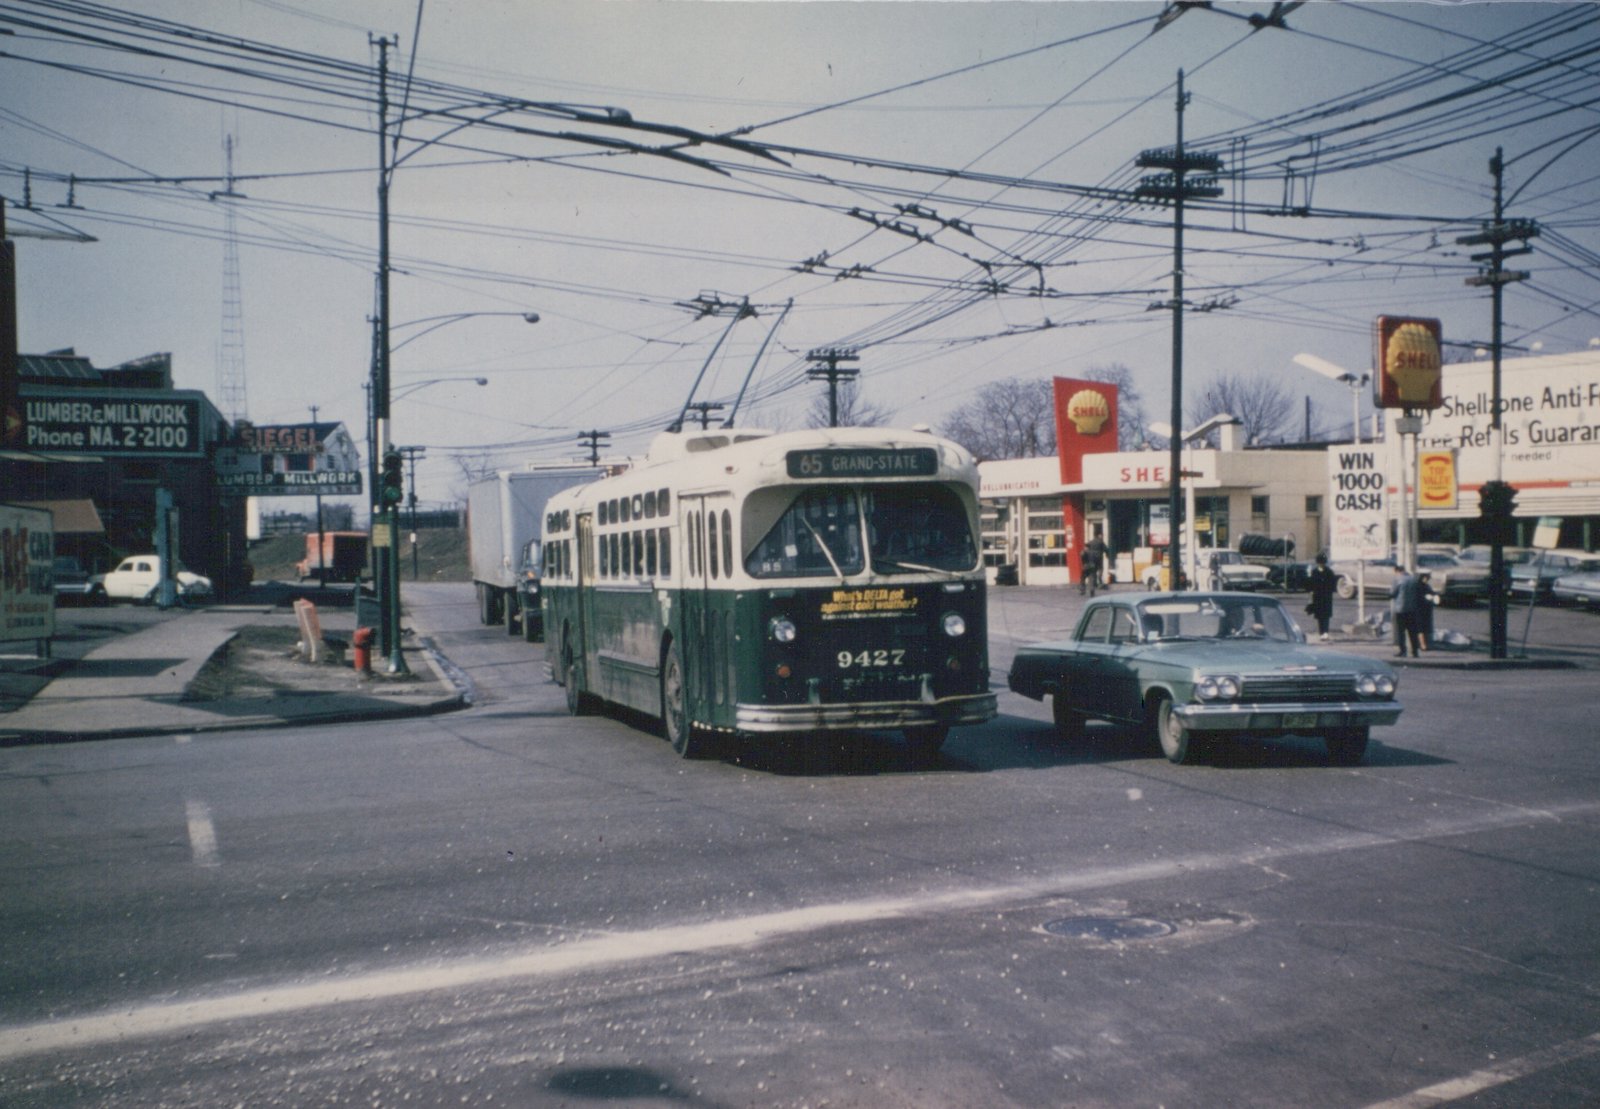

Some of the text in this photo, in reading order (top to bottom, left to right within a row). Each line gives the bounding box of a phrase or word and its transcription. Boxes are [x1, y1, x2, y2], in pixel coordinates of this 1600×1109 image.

[1396, 351, 1439, 370] SHELL
[1073, 406, 1105, 417] SHELL
[27, 425, 187, 448] Phone NA. 2-2100
[240, 428, 318, 447] SIEGEL
[1461, 423, 1519, 448] Refls
[800, 454, 918, 474] 65 GRAND-STATE
[1340, 452, 1374, 470] WIN
[1511, 451, 1552, 463] needed
[284, 472, 357, 485] MILLWORK
[1121, 467, 1189, 482] SHEL
[1335, 494, 1381, 511] CASH
[837, 649, 906, 669] 9427
